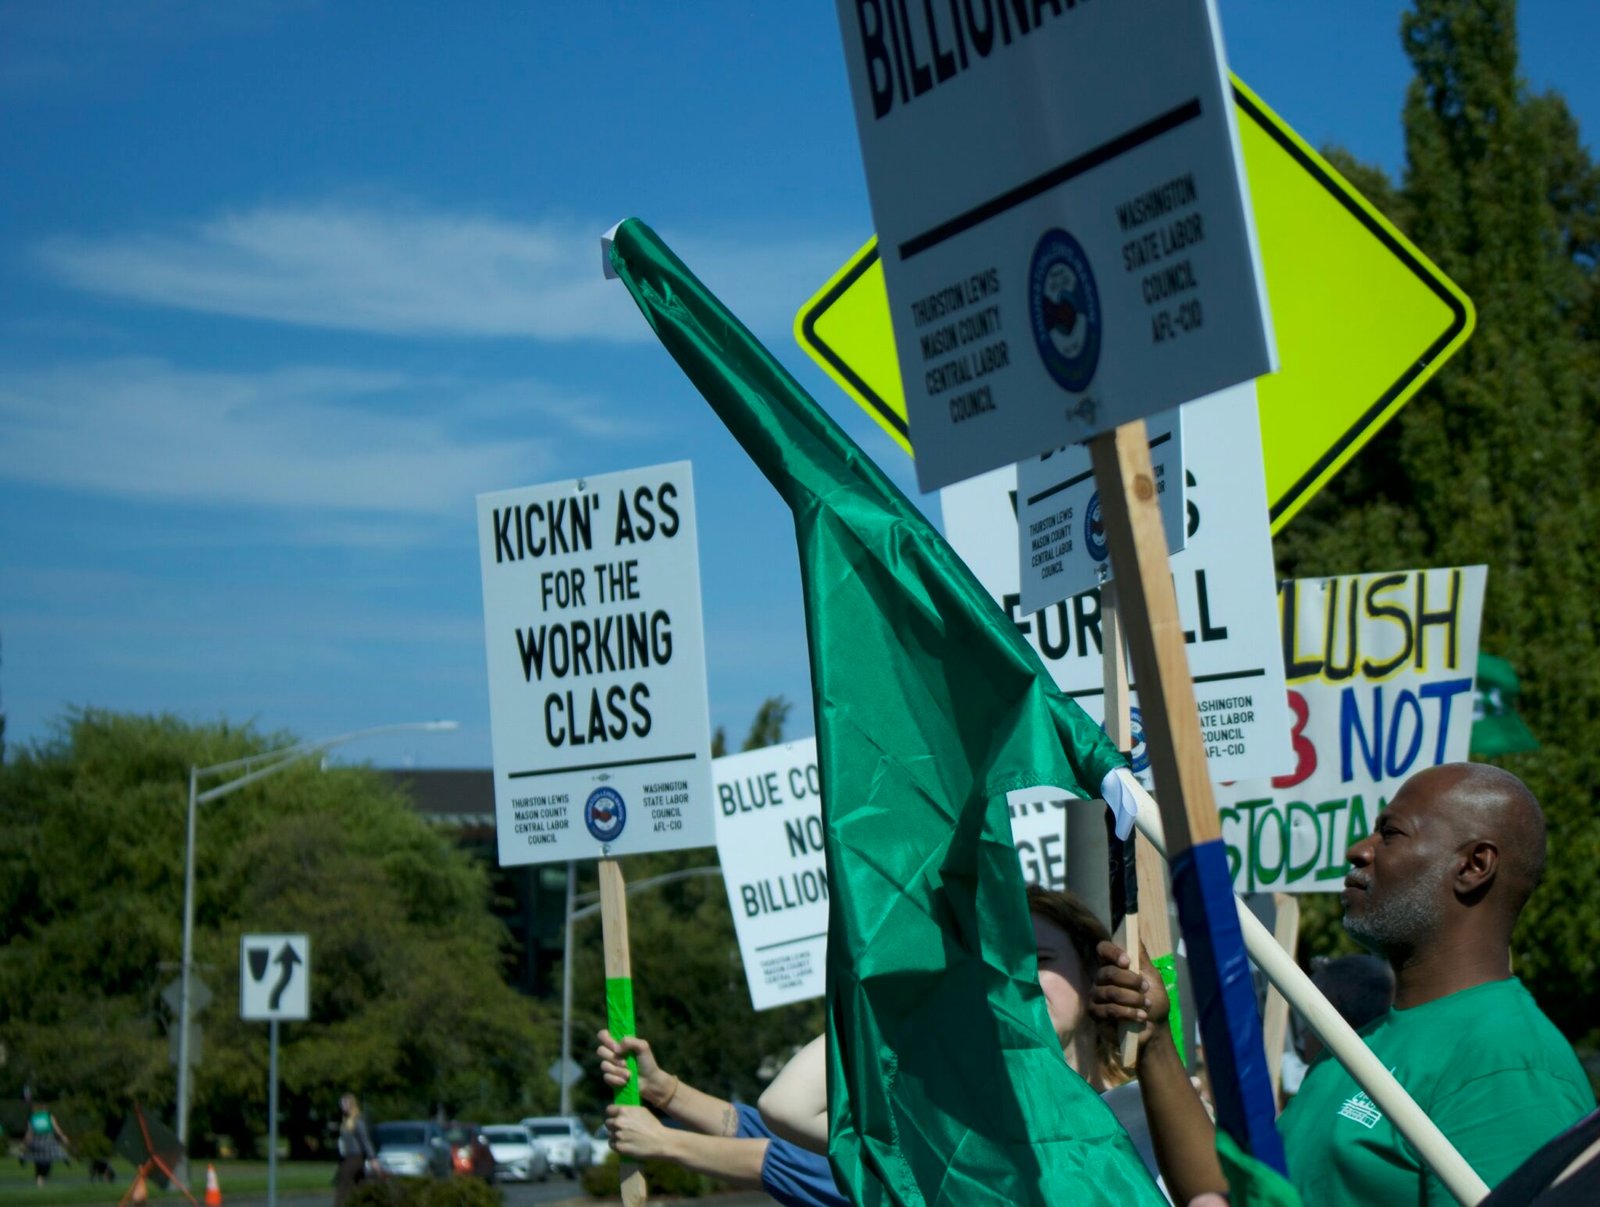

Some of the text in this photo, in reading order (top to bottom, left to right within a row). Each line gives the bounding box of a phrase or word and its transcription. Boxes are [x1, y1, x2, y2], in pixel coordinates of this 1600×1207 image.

[1116, 171, 1197, 231] WASHINGTON
[1122, 211, 1204, 272] STATE LABOR
[911, 267, 999, 328] THURSTON LEWIS
[1142, 259, 1197, 305] COUNCIL
[920, 304, 1001, 361] MASON COUNTY
[1152, 298, 1203, 344] AFL-CIO
[925, 340, 1009, 396] CENTRAL LABOR
[950, 383, 996, 423] COUNCIL
[493, 482, 680, 563] KICKN' ASS
[1029, 507, 1073, 536] THURSTON LEWIS
[1032, 524, 1071, 551] MASON COUNTY
[1031, 540, 1073, 567] CENTRAL LABOR
[1042, 561, 1064, 579] COUNCIL
[541, 559, 640, 611] FOR THE
[1278, 570, 1462, 684] LUSH
[515, 609, 672, 682] WORKING
[544, 682, 651, 748] CLASS
[1197, 696, 1253, 712] SHINGTON
[1220, 711, 1254, 726] LABOR
[1201, 728, 1244, 743] COUNCIL
[1340, 677, 1472, 782] NOT
[512, 794, 569, 808] THURSTON LEWIS
[643, 781, 688, 793] WASHINGTON
[643, 793, 689, 807] STATE LABOR
[718, 772, 782, 817] BLUE
[514, 807, 567, 821] MASON COUNTY
[515, 819, 569, 834] CENTRAL LABOR
[651, 807, 682, 818] COUNCIL
[653, 820, 682, 832] AFL-CIO
[528, 833, 557, 845] COUNCIL
